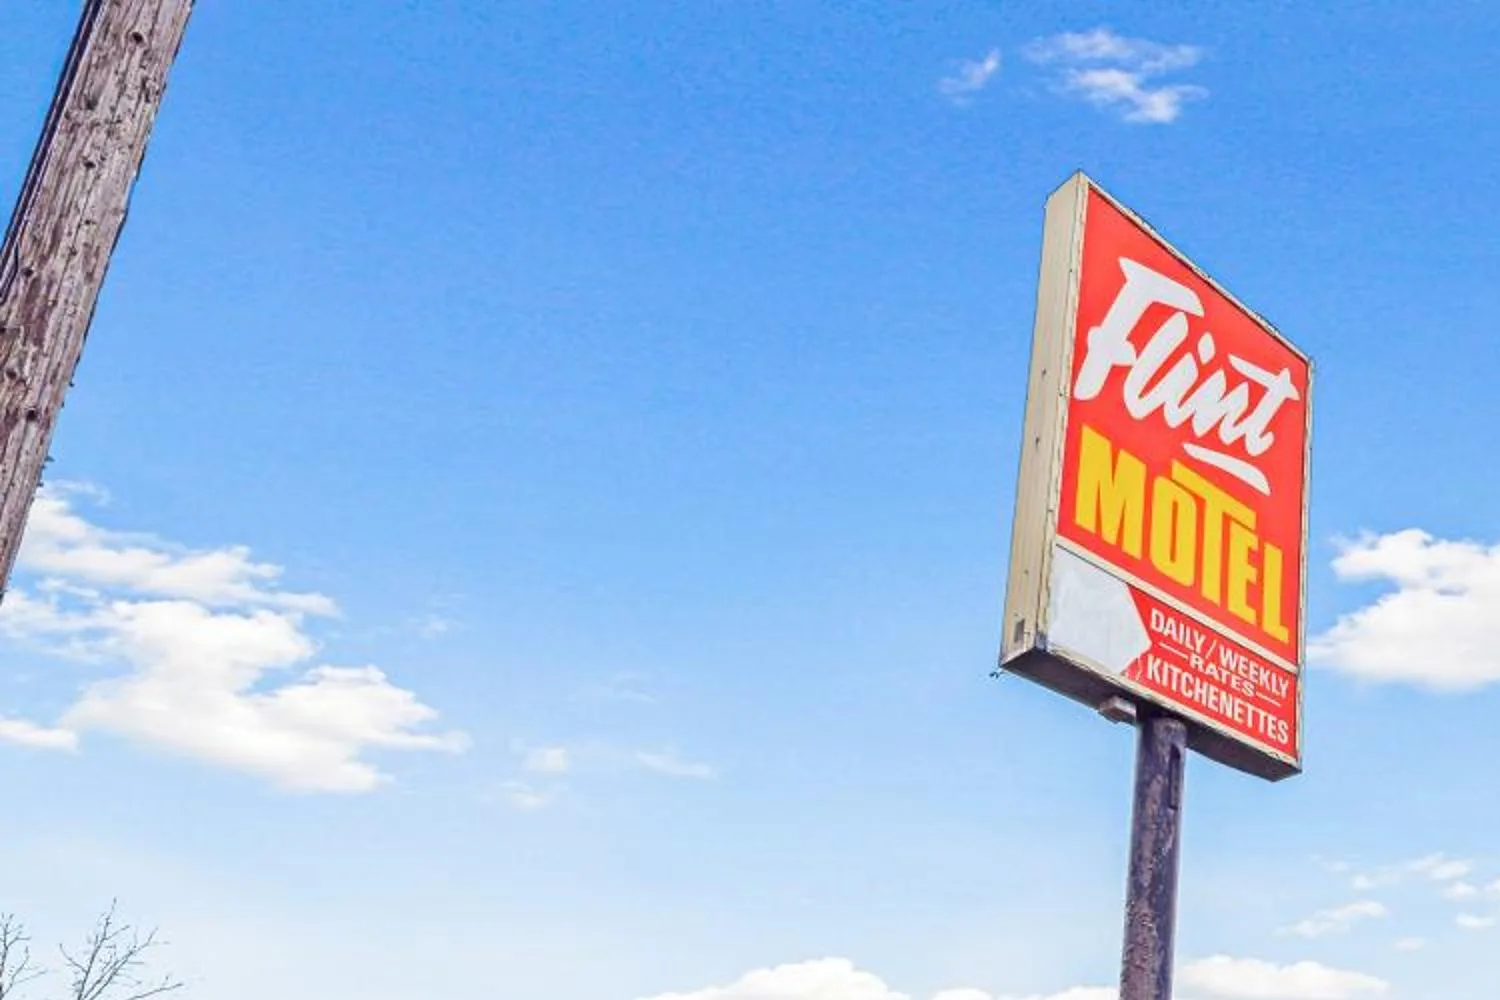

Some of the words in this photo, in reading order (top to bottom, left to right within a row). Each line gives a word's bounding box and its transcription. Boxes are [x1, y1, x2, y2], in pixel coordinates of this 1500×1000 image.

[1073, 256, 1300, 457] Flint
[1075, 424, 1290, 645] MOTEL
[1147, 653, 1289, 745] KITCHENETTES
[1189, 652, 1256, 698] RATES
